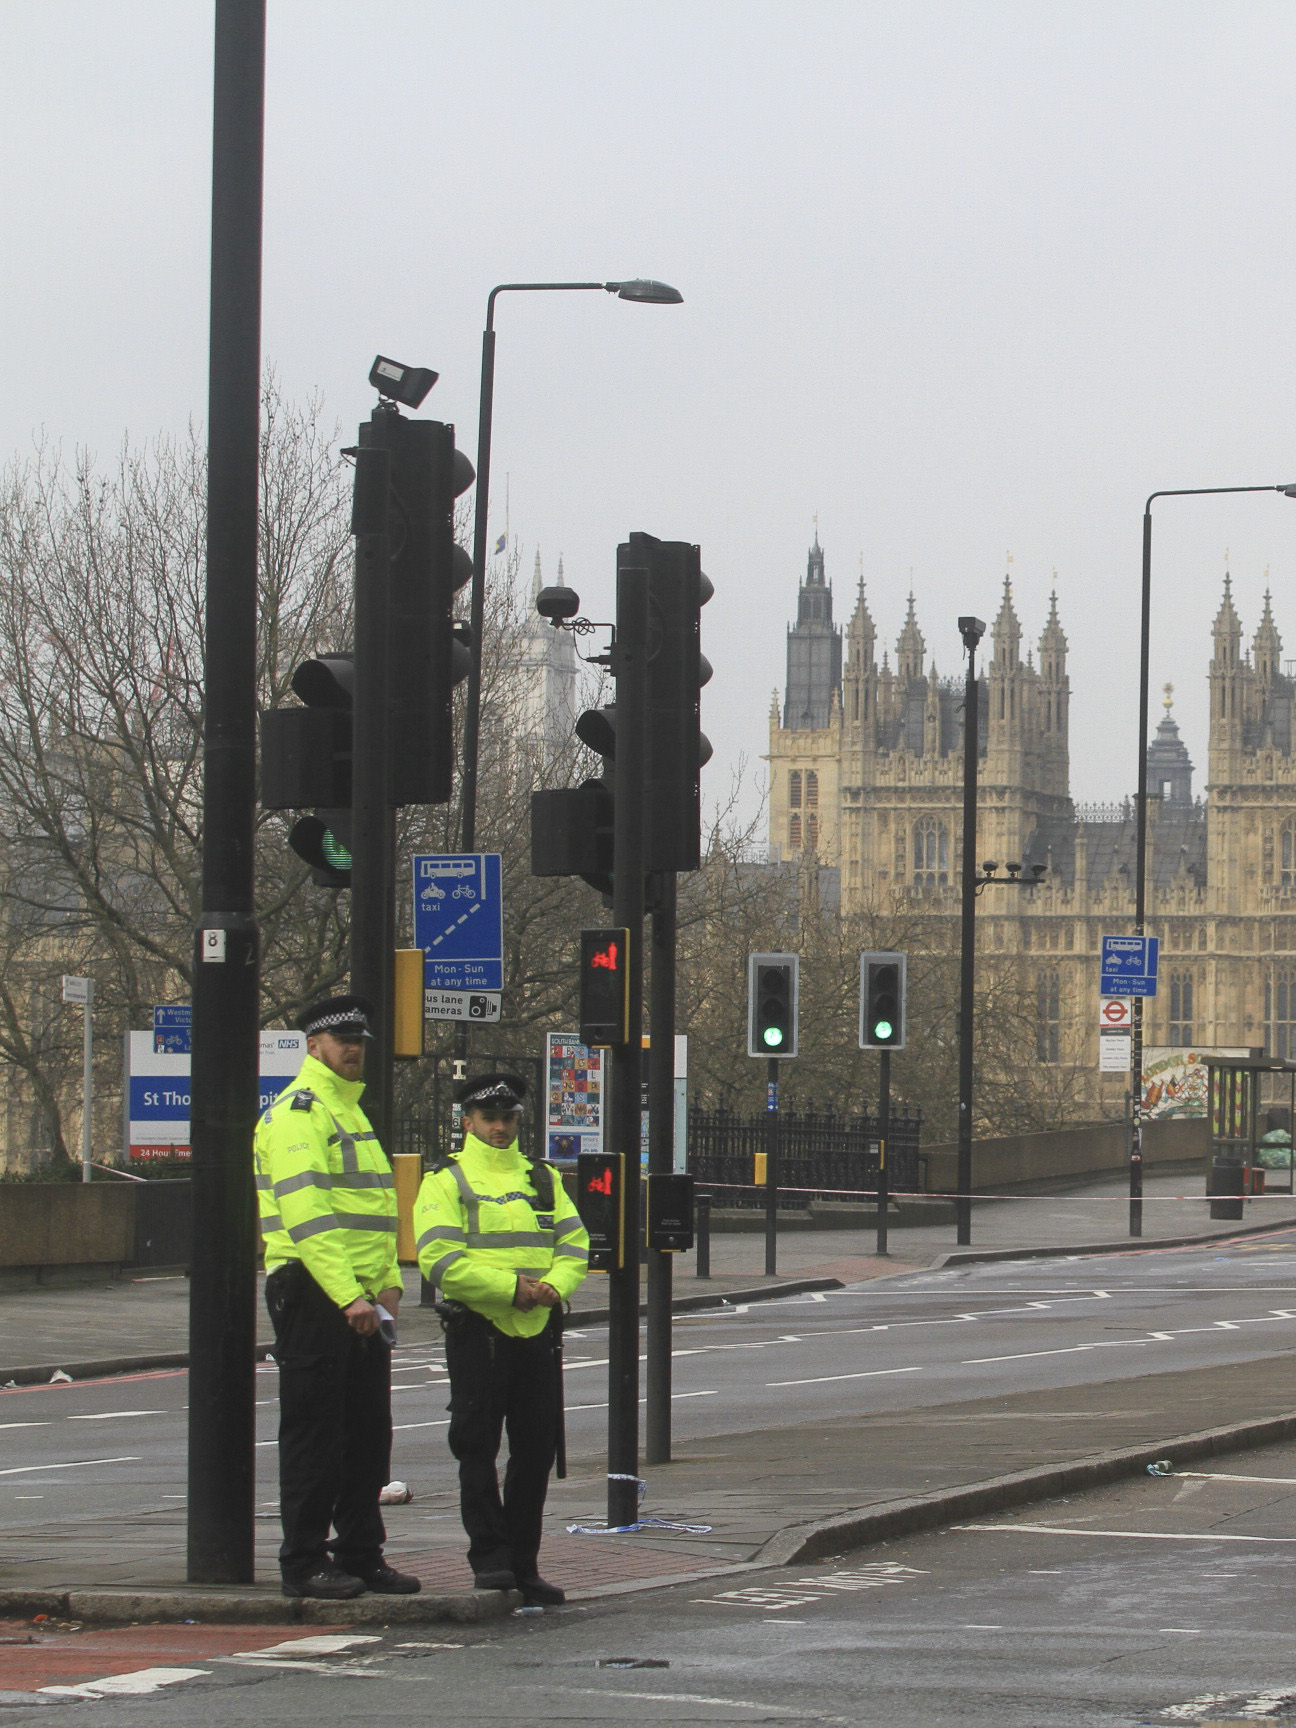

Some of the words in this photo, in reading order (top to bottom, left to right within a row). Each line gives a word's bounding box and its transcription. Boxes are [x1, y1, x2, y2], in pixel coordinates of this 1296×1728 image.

[421, 902, 441, 911] taxi
[207, 931, 218, 947] 8
[434, 965, 457, 974] Mon
[464, 964, 484, 973] Sun
[430, 978, 442, 986] at
[444, 978, 462, 987] any
[465, 977, 488, 986] time
[441, 994, 464, 1004] lane
[425, 1006, 462, 1015] ameras
[279, 1040, 299, 1048] NHS
[144, 1092, 160, 1106] St
[140, 1149, 150, 1157] 24
